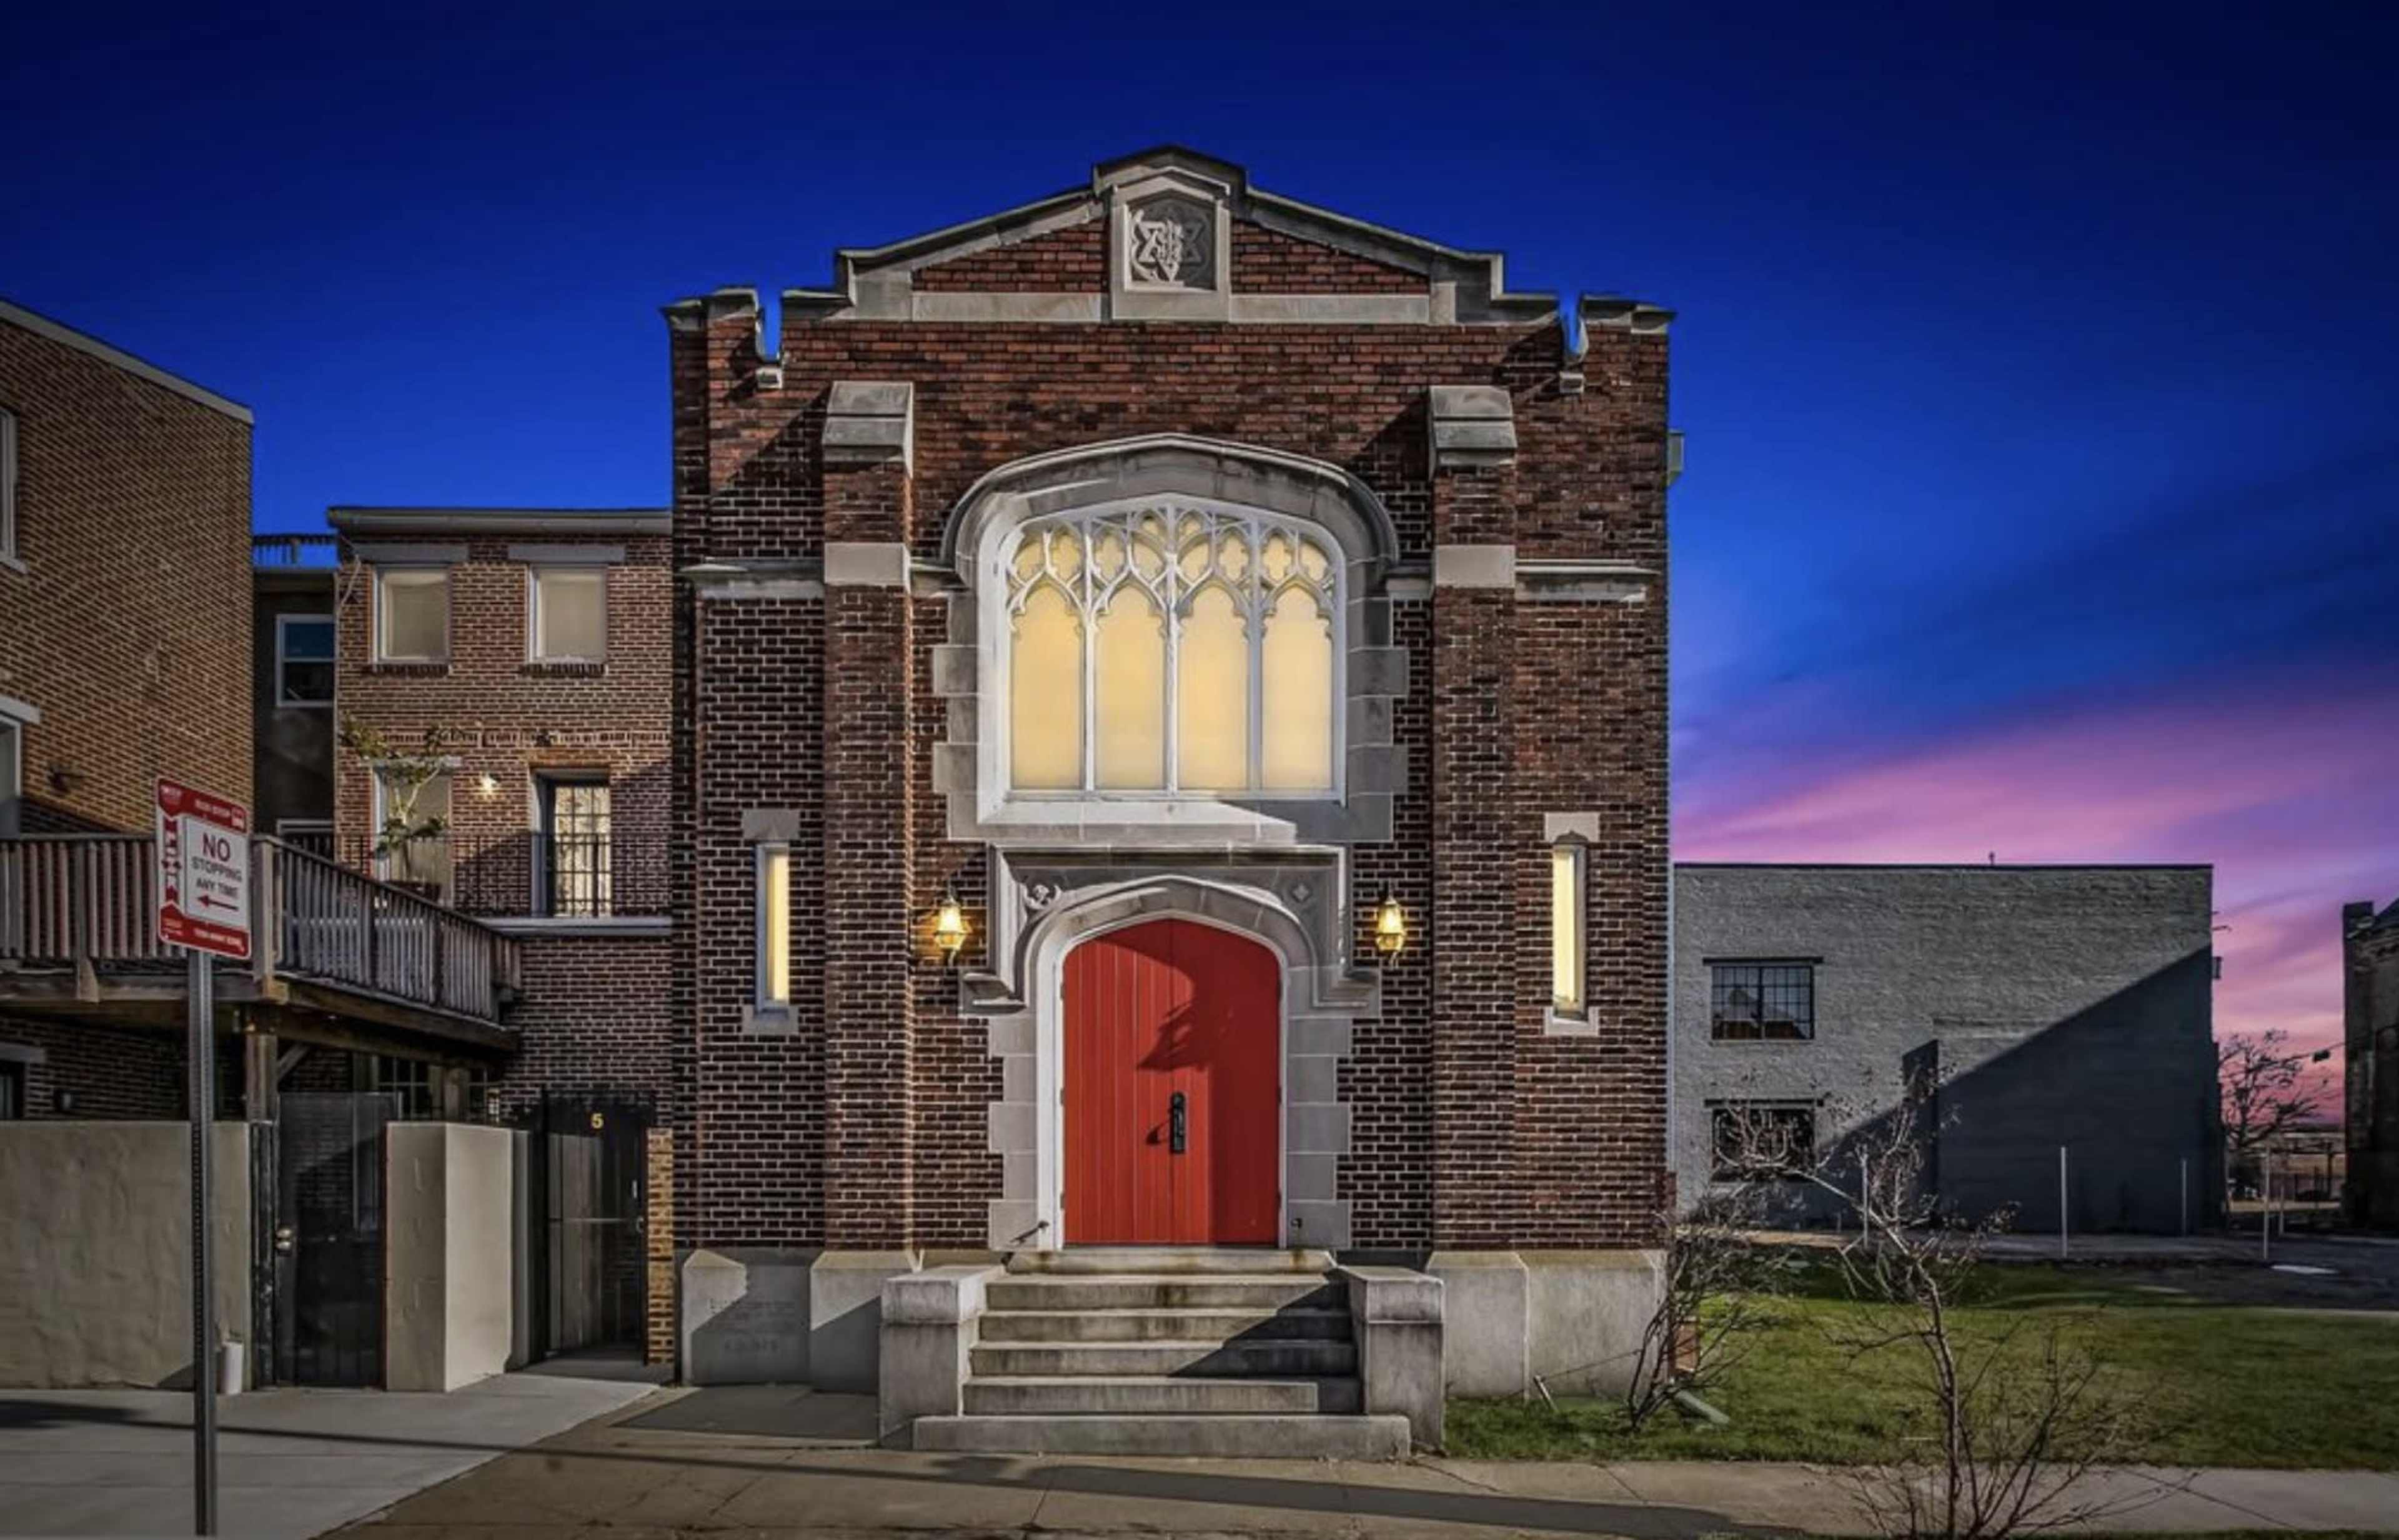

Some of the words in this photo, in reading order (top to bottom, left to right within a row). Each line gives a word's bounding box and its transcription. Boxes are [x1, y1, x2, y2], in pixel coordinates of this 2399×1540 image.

[203, 832, 231, 862] NO
[191, 856, 242, 882] STOPPING
[196, 877, 215, 891] ANY
[218, 882, 239, 898] TIME
[591, 1113, 604, 1128] 5
